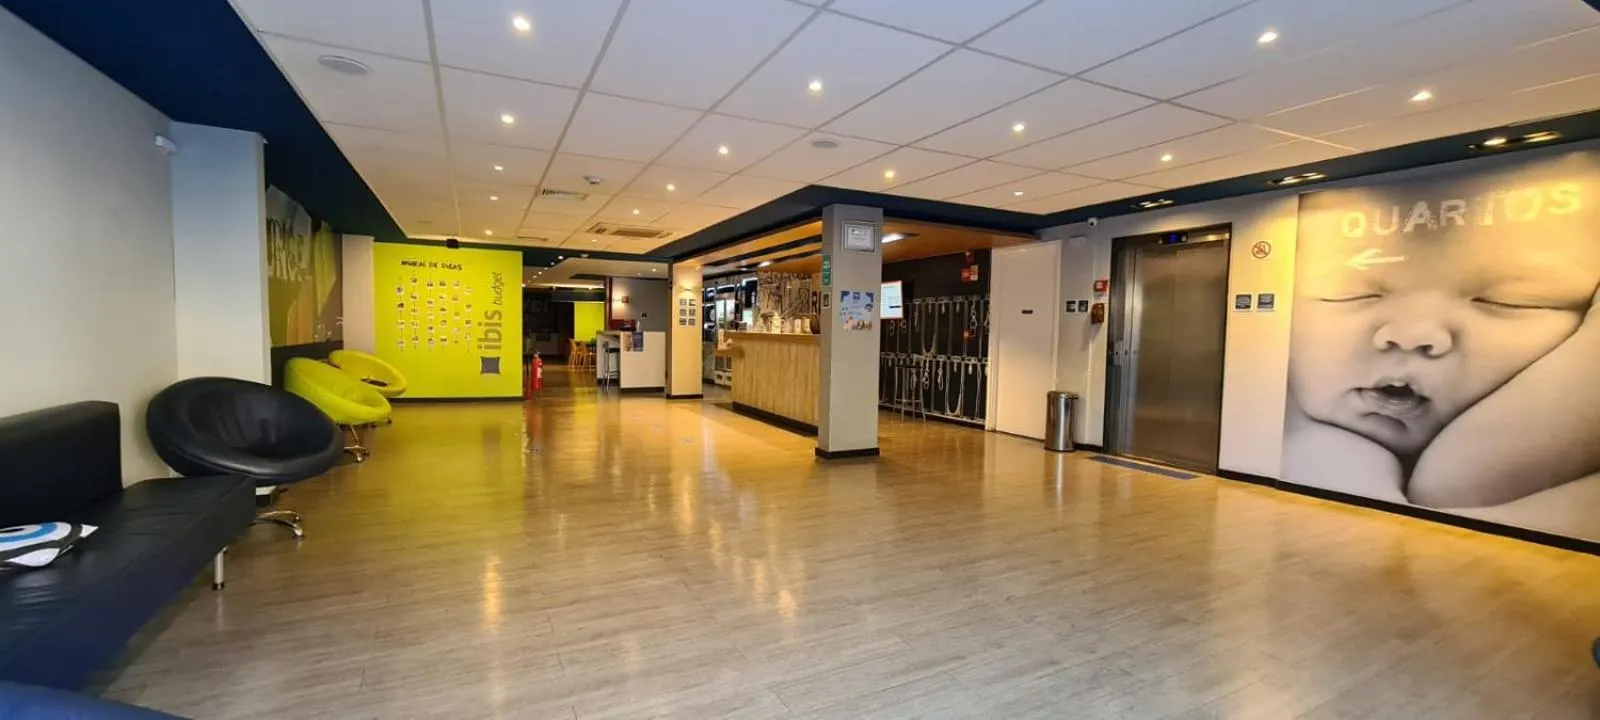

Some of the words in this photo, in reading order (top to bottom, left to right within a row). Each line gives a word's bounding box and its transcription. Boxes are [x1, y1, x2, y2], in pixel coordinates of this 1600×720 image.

[1341, 182, 1583, 238] QUARTOS
[478, 310, 502, 350] ibis
[491, 272, 504, 305] budget
